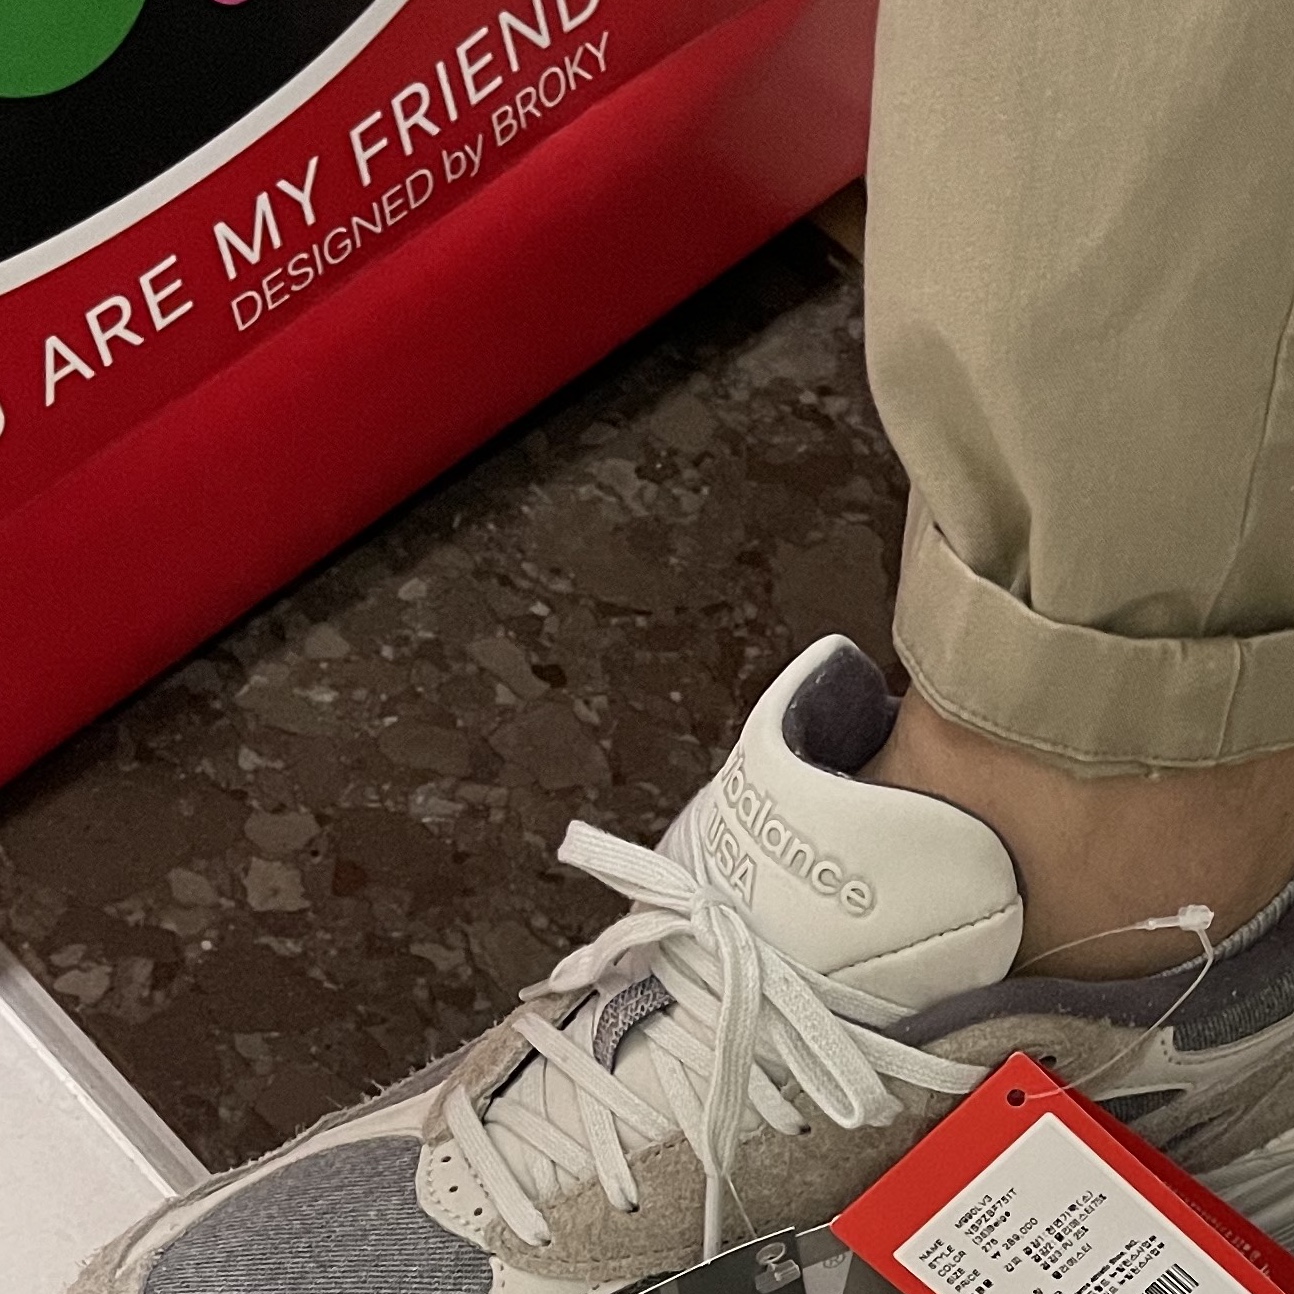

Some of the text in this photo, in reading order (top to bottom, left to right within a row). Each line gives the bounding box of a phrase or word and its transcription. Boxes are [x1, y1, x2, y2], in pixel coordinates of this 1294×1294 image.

[230, 31, 609, 331] DESIGNED by BROKY
[45, 254, 193, 406] ARE
[213, 158, 320, 280] MY
[722, 750, 876, 917] balance
[918, 1238, 944, 1261] NAME
[927, 1244, 955, 1270] STYLE
[936, 1249, 967, 1277] COLOR
[945, 1266, 966, 1285] SIZE
[954, 1268, 981, 1293] PRICE
